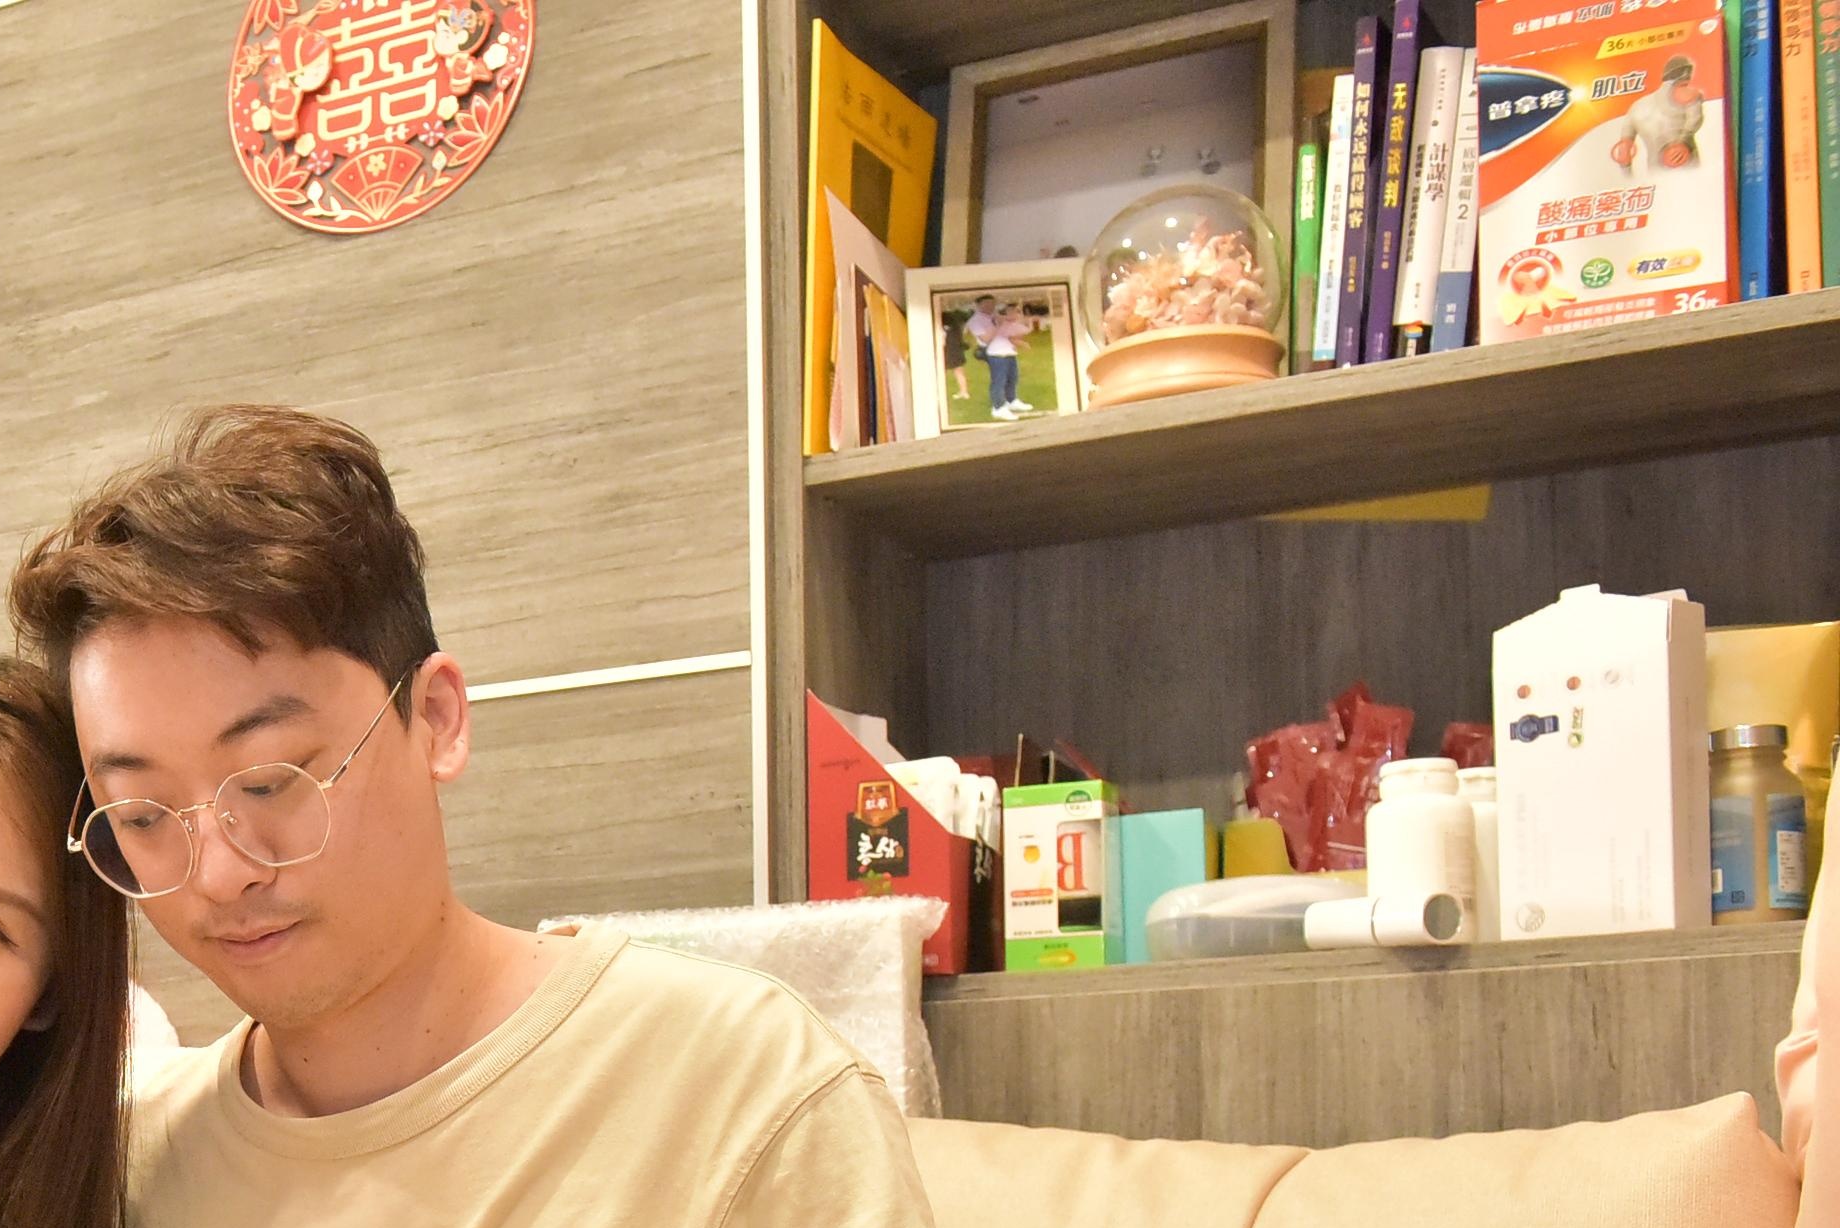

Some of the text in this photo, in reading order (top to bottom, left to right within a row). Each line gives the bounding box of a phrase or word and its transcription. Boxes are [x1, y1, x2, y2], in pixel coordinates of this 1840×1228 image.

[1591, 70, 1648, 101] 肌立
[1487, 88, 1566, 121] 普拿疼
